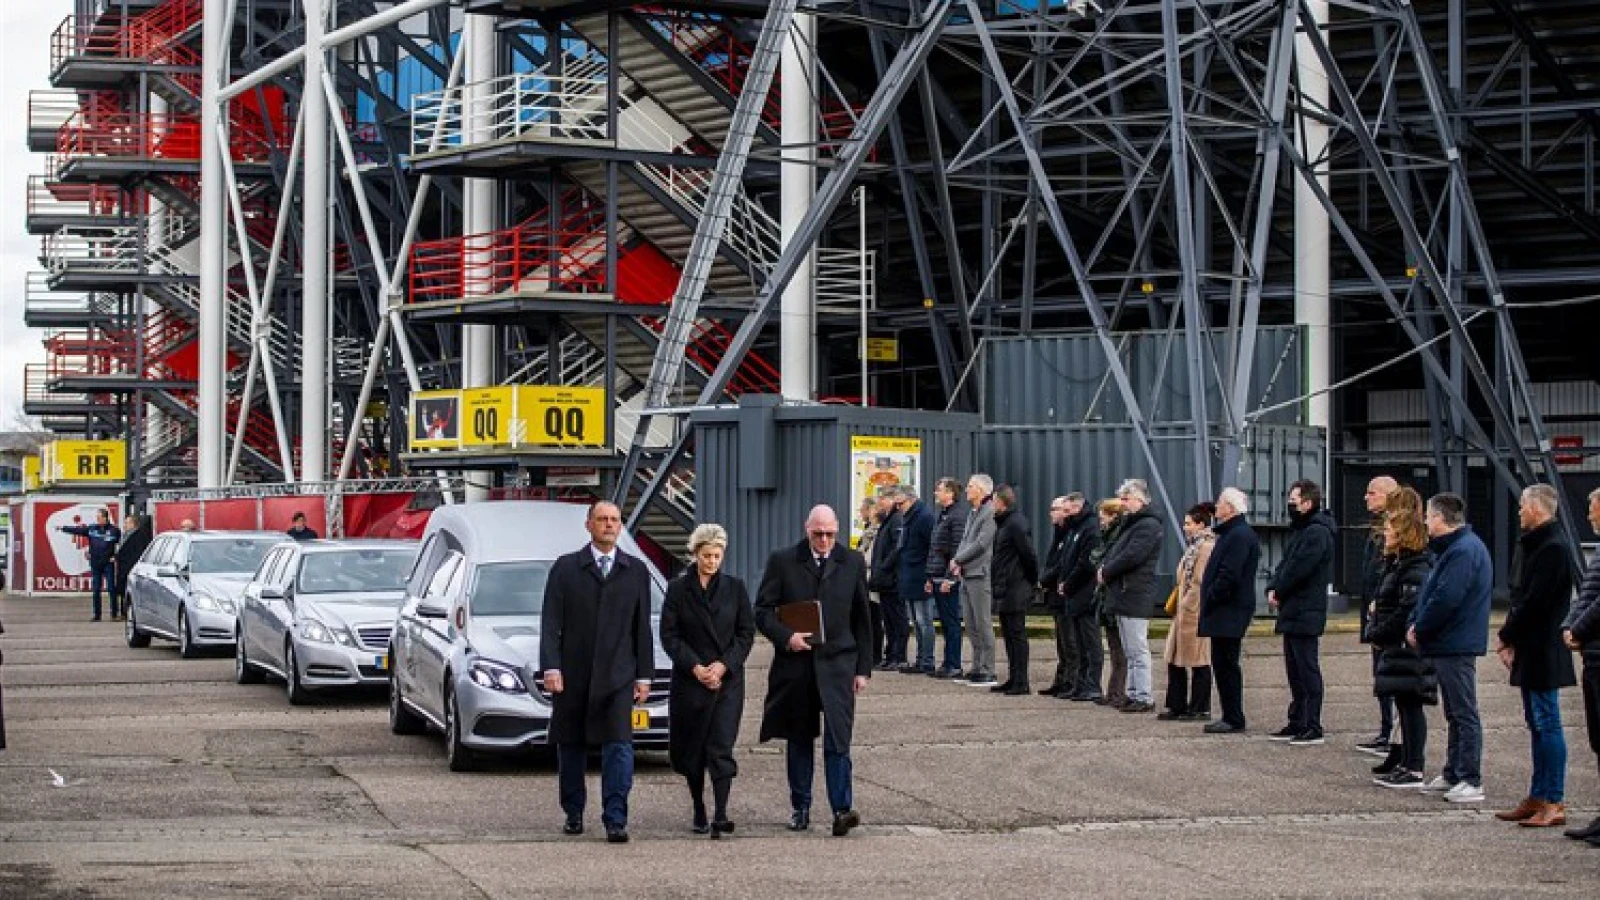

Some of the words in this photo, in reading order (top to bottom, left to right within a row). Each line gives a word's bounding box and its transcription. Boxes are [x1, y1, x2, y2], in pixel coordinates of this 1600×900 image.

[475, 408, 498, 441] QQ
[545, 406, 585, 440] QQ
[78, 455, 109, 475] RR
